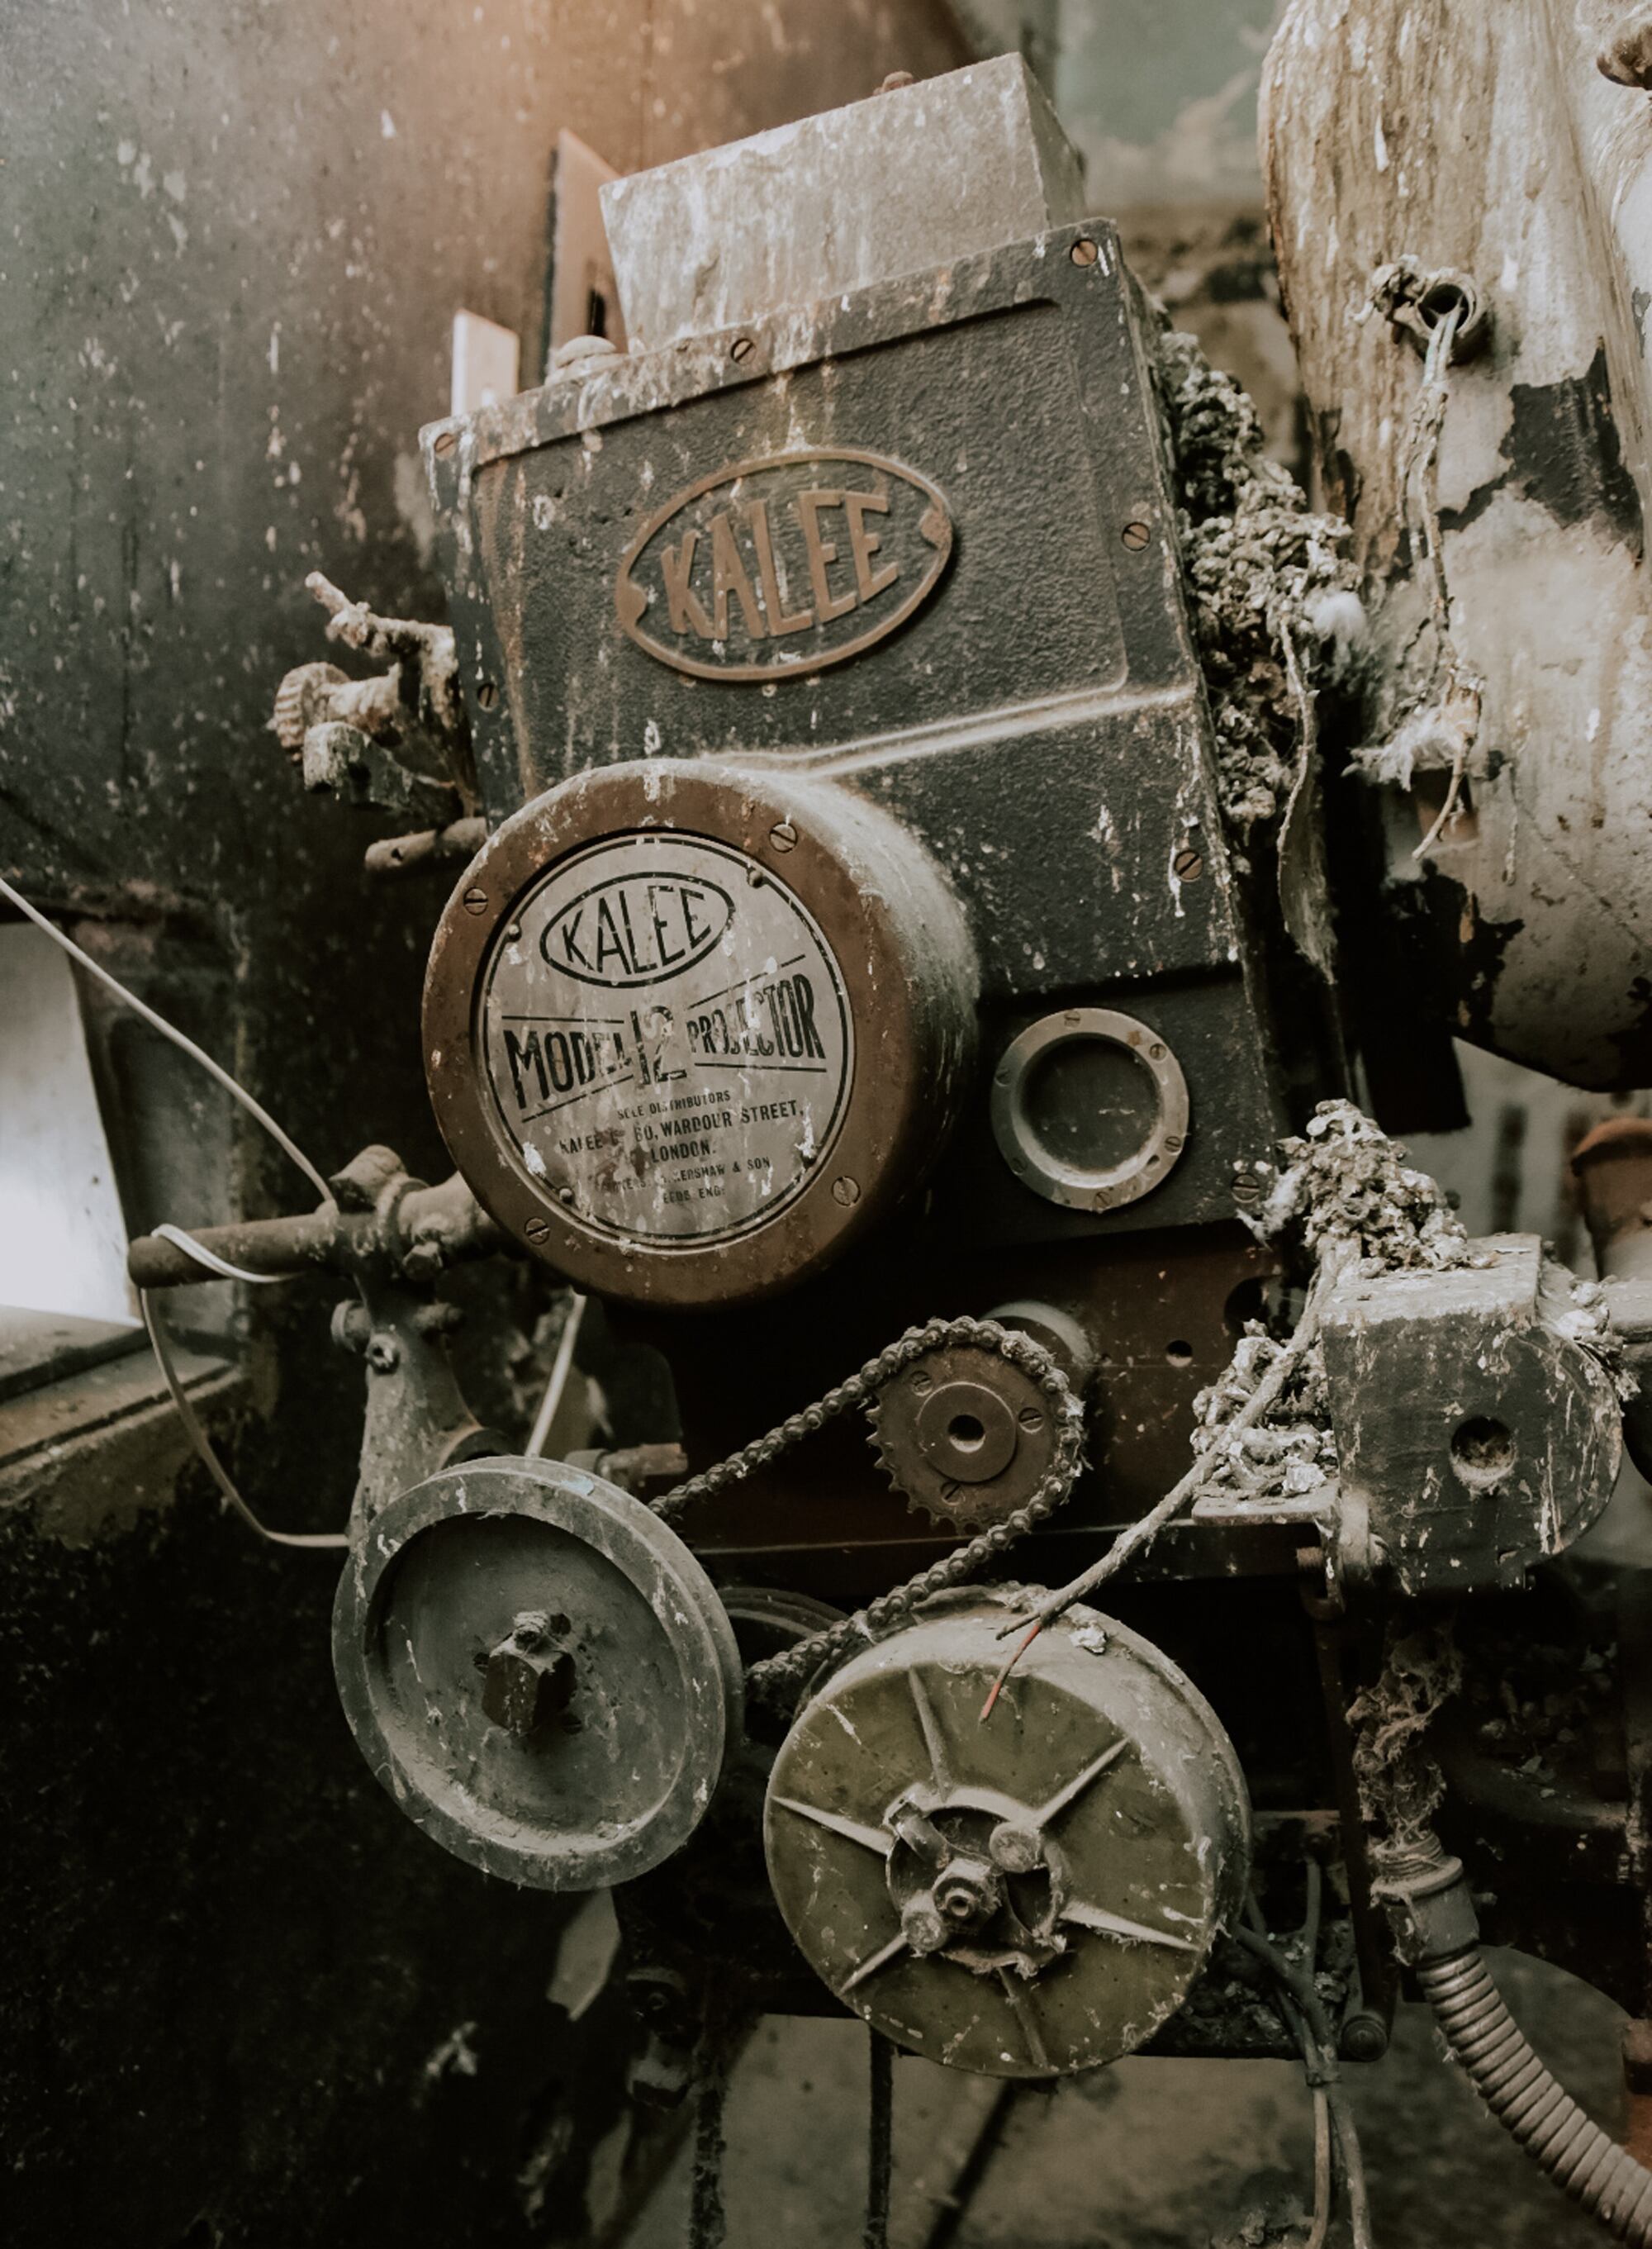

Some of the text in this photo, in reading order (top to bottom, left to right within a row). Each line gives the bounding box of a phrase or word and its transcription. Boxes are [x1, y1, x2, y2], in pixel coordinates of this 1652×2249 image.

[662, 489, 898, 640] KALEE
[562, 886, 714, 975] KALEE
[629, 1006, 688, 1086] 12
[661, 1111, 733, 1138] WARDOUR
[741, 1100, 805, 1124] STREET,
[650, 1139, 717, 1163] LONDON.
[732, 1161, 741, 1172] &
[747, 1158, 771, 1171] SON
[662, 1189, 691, 1204] EEDS
